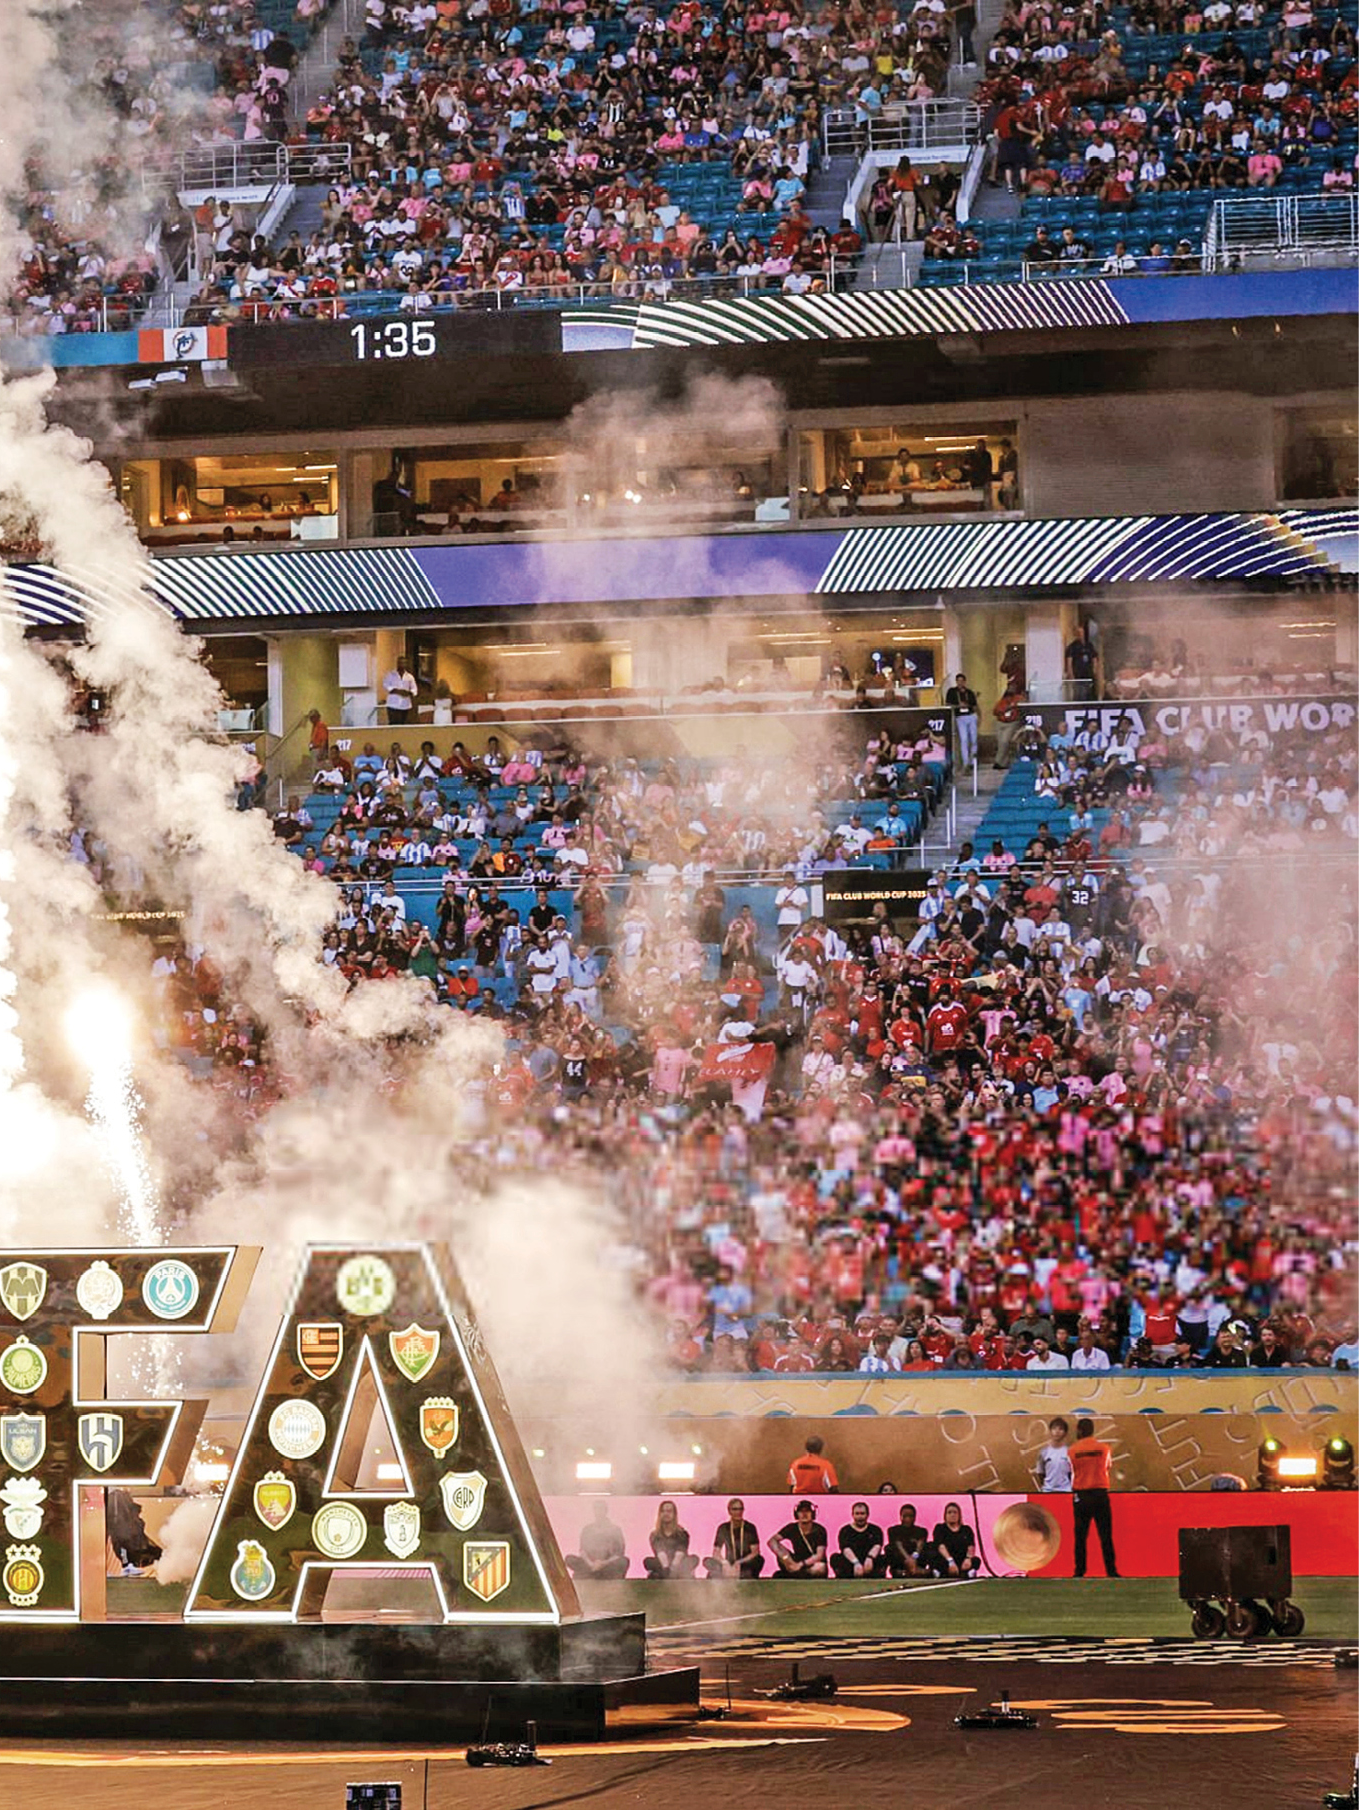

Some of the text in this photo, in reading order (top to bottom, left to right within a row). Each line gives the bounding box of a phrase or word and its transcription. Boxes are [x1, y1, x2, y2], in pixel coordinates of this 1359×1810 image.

[350, 320, 436, 359] 1:35
[1064, 698, 1147, 739] FIFA
[1263, 702, 1359, 732] WOR
[825, 893, 843, 901] FIFA
[843, 892, 863, 900] CLUB
[863, 891, 891, 900] WORLD
[891, 891, 907, 899] CUP
[1072, 890, 1089, 905] 32
[566, 1061, 582, 1077] 44
[153, 1265, 188, 1281] PARIS
